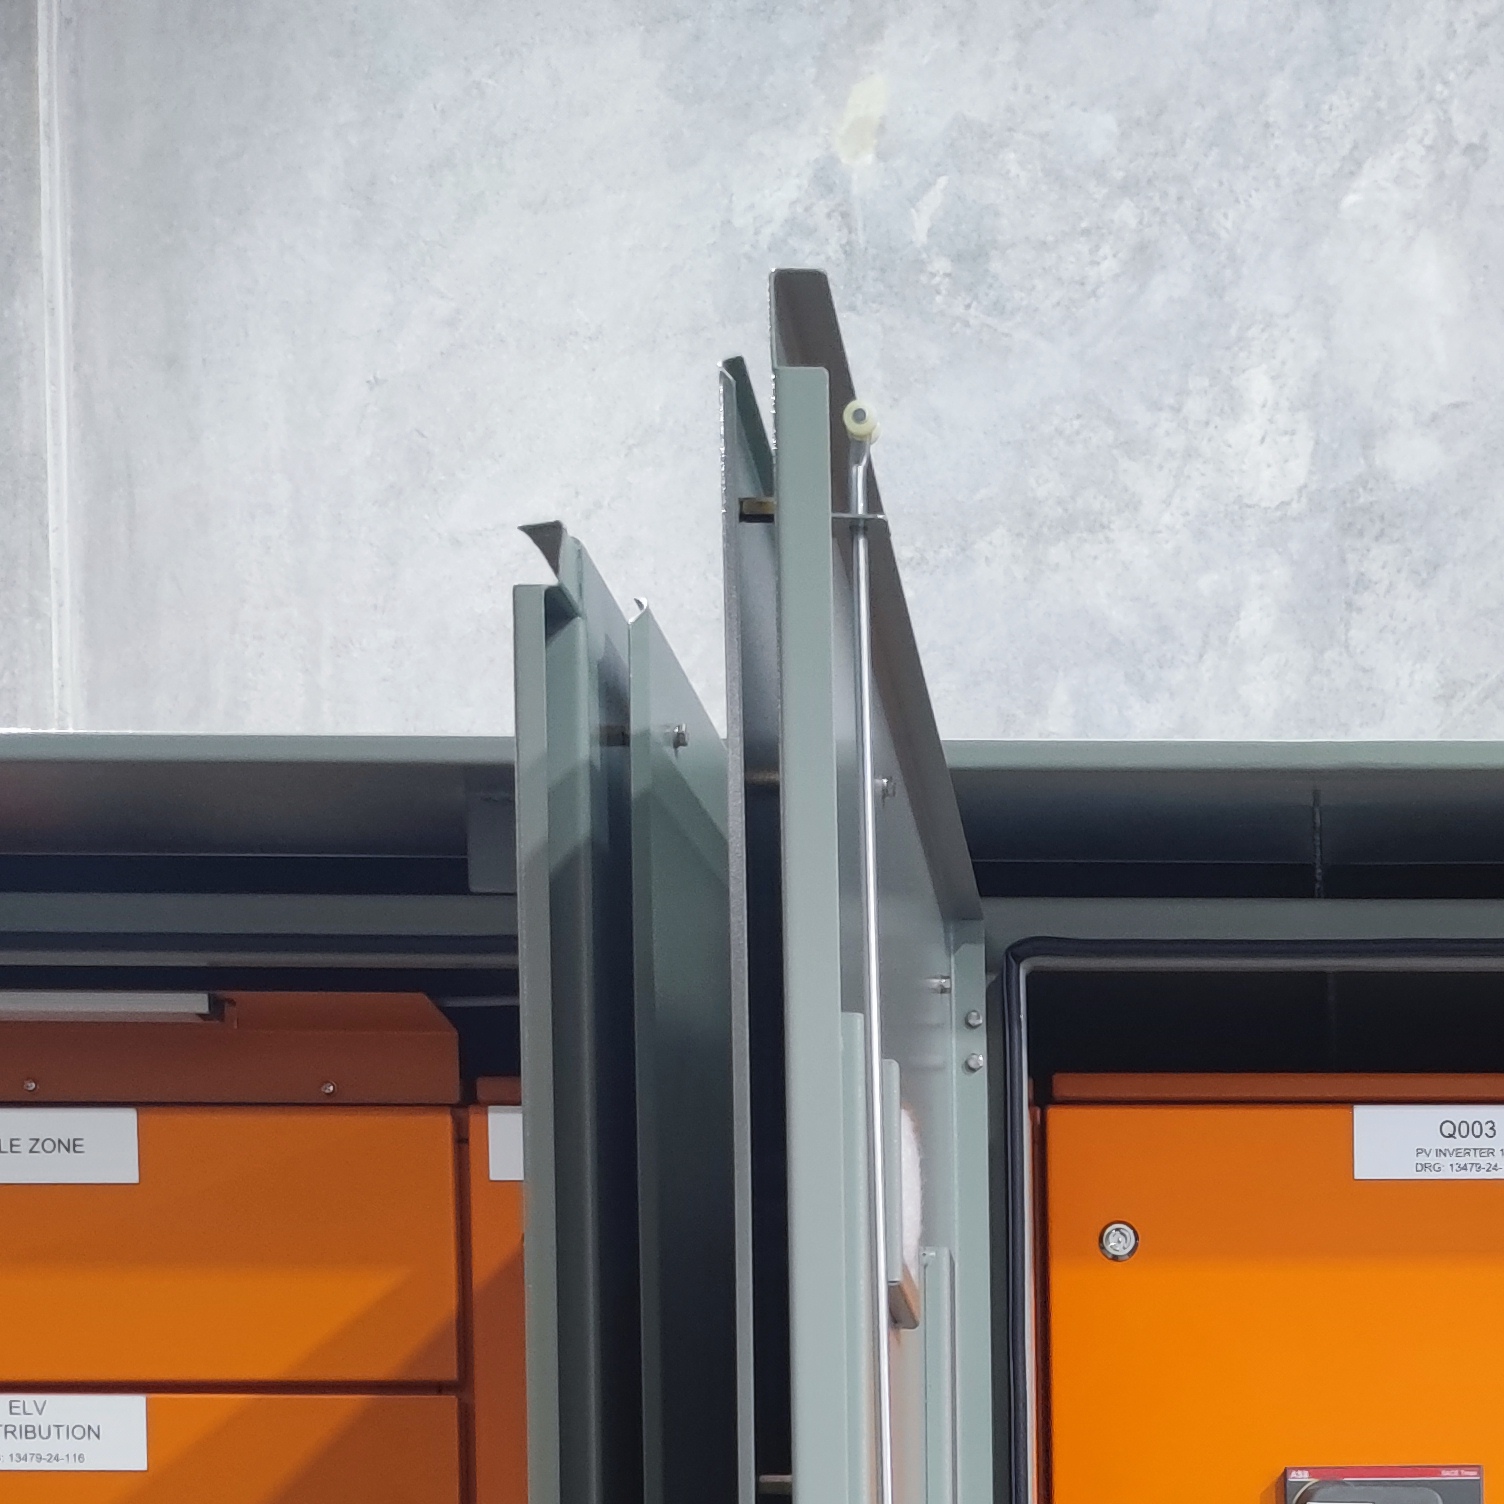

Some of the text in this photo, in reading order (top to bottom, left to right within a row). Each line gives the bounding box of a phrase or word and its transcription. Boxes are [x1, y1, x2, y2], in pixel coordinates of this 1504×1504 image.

[1439, 1120, 1497, 1140] Q003
[28, 1137, 86, 1154] ZONE
[1415, 1148, 1433, 1158] PV
[1435, 1148, 1496, 1158] INVERTER
[8, 1399, 48, 1416] ELV
[8, 1453, 86, 1464] 13479-24-116
